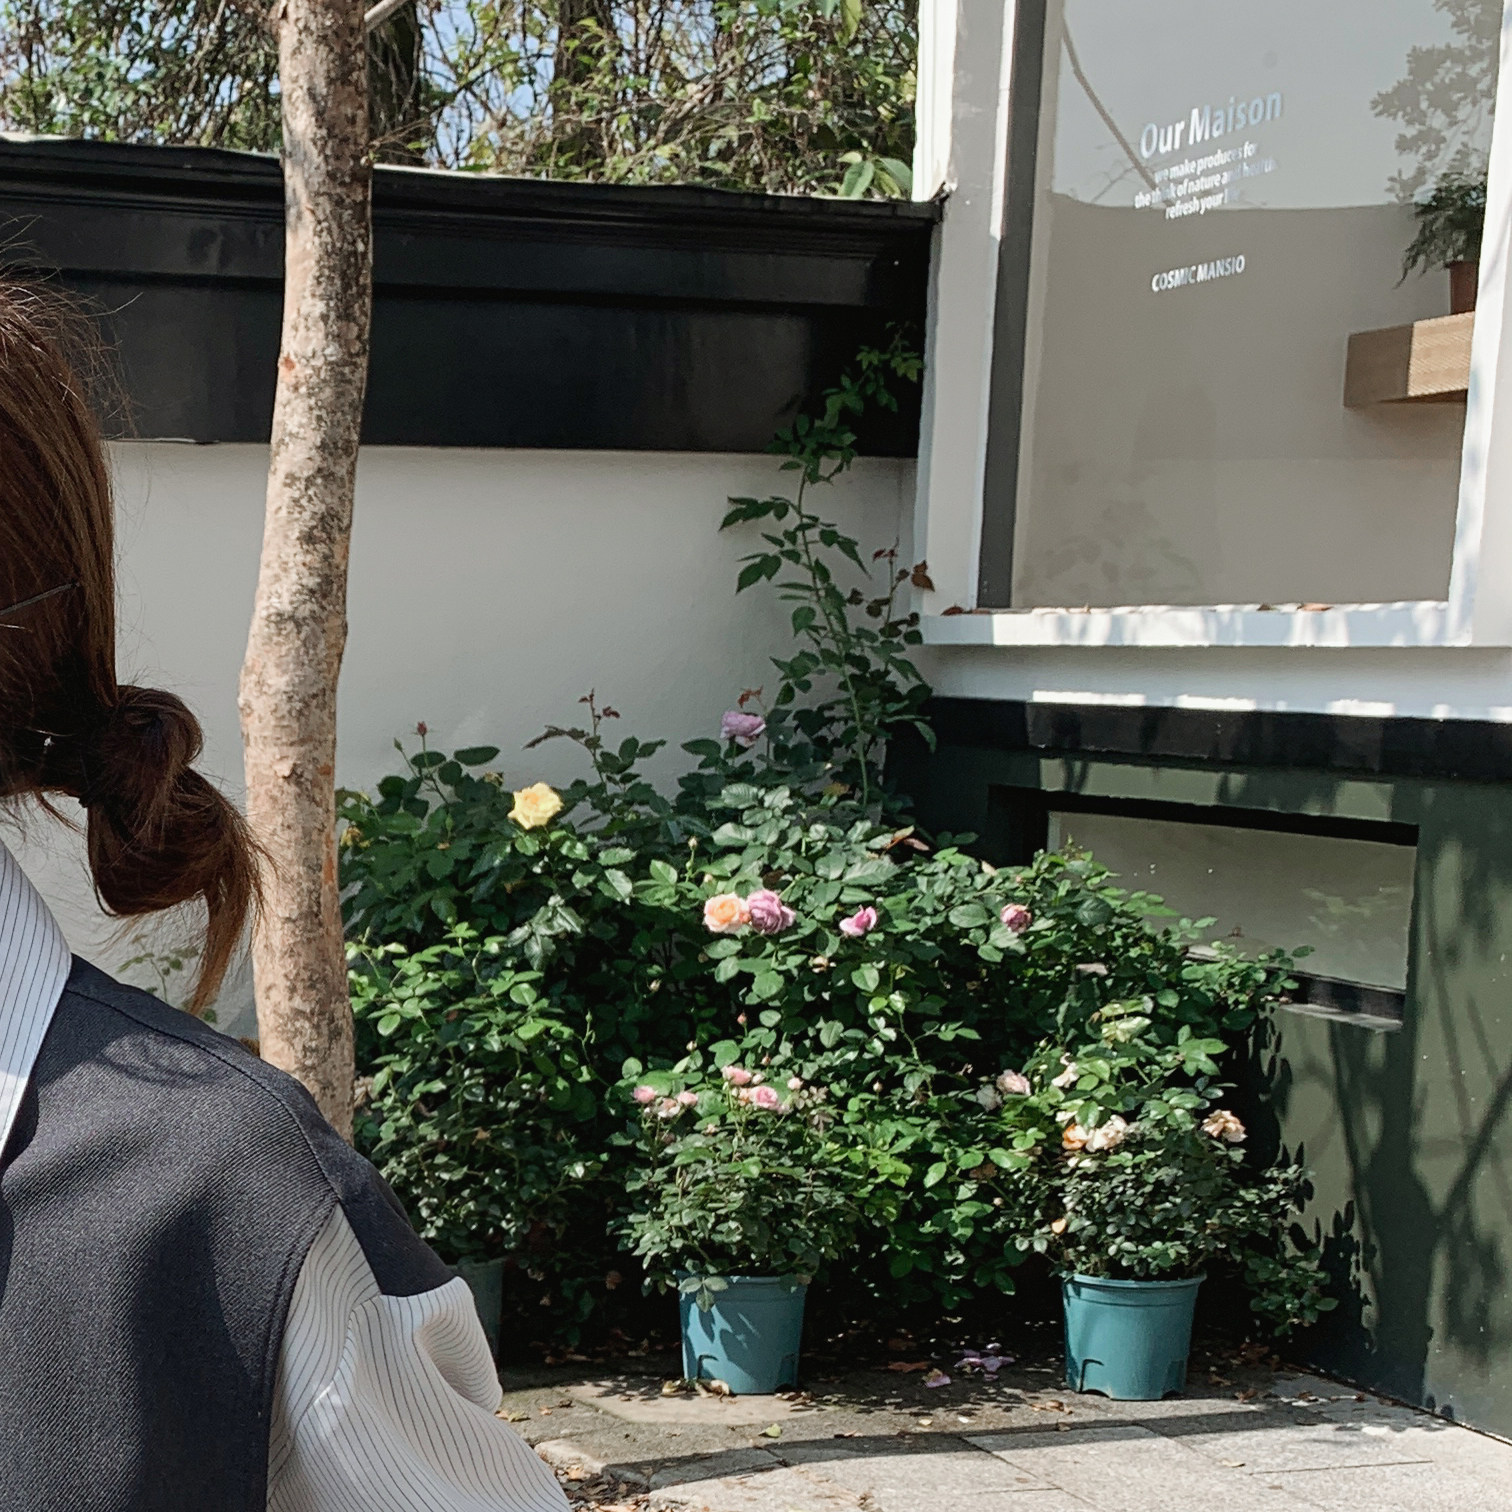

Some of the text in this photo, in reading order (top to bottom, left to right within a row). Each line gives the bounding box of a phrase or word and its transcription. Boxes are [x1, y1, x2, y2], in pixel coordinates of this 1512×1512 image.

[1140, 91, 1283, 159] Our Maison
[1169, 158, 1197, 179] make
[1134, 191, 1152, 208] the
[1176, 178, 1188, 198] of
[1188, 172, 1221, 194] nature
[1165, 197, 1200, 220] refresh
[1199, 192, 1223, 215] your
[1151, 254, 1246, 292] COSMIC MANSIO
